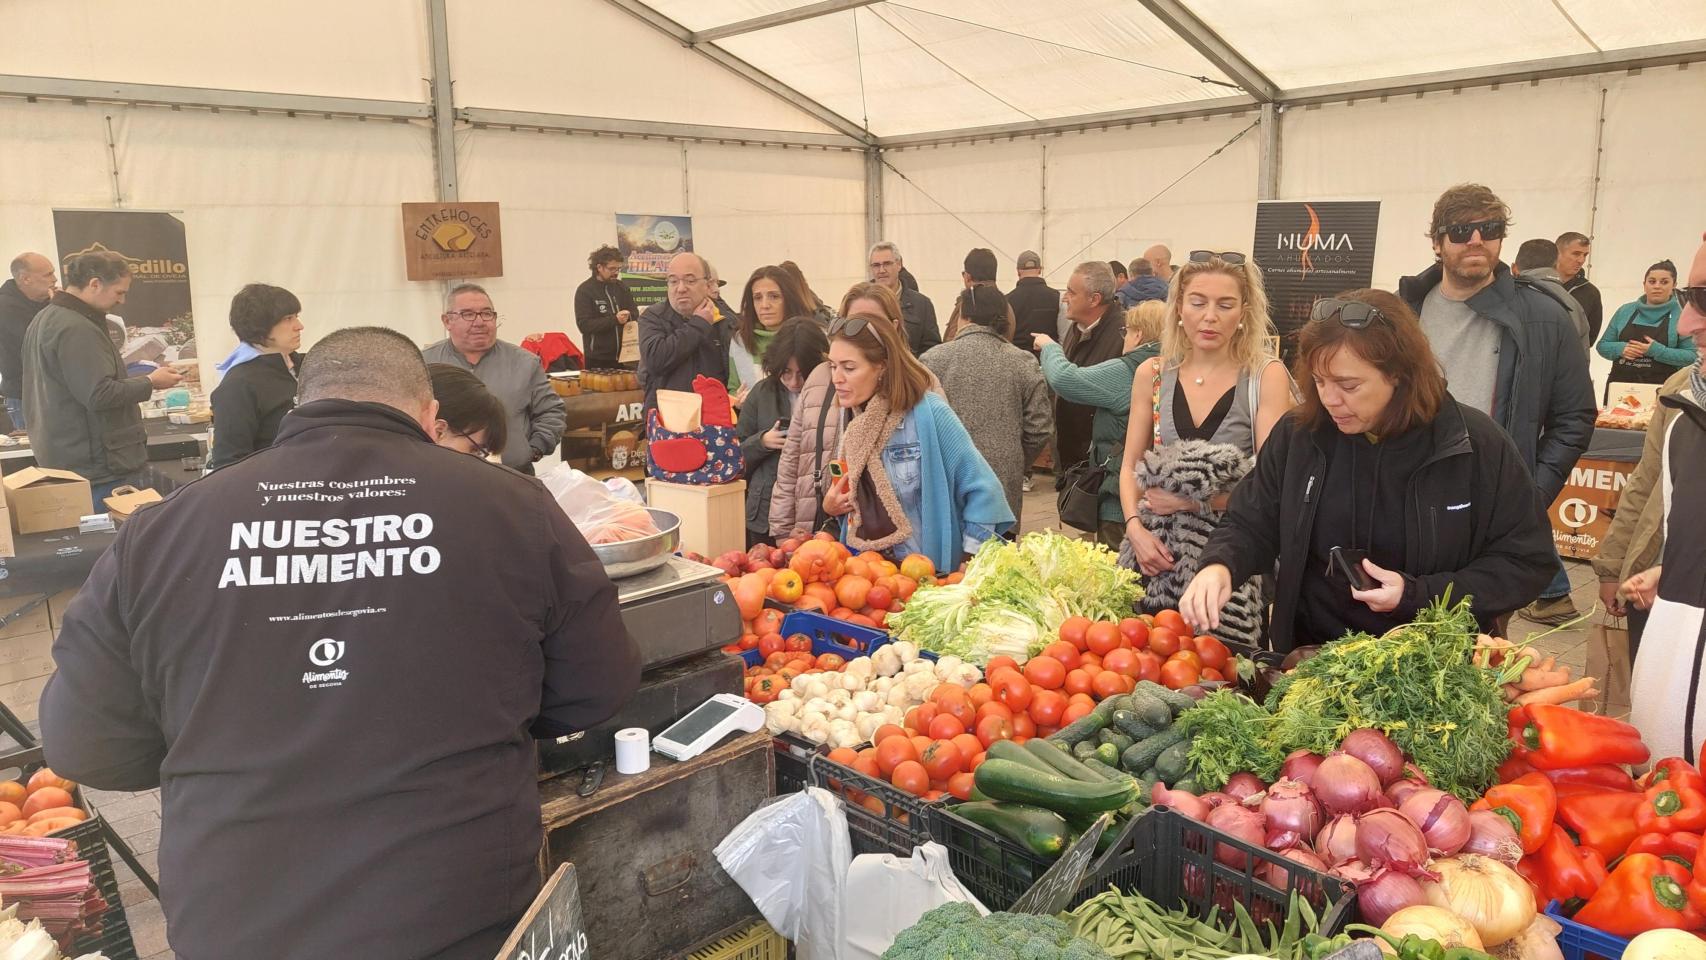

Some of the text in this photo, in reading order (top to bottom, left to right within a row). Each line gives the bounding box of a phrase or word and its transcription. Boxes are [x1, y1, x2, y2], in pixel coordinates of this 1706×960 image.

[415, 208, 492, 241] ENTREHOCES
[128, 259, 186, 274] edillo
[1277, 254, 1351, 263] AHUADOS
[256, 476, 416, 491] Nuestras costumbres
[1565, 468, 1632, 491] MEN
[261, 487, 407, 506] y nuestros valores:
[230, 513, 434, 550] NUESTRO
[218, 545, 441, 589] ALIMENTO
[268, 606, 387, 622] www.alimentosdesegovia.es
[302, 668, 350, 684] Alimentos
